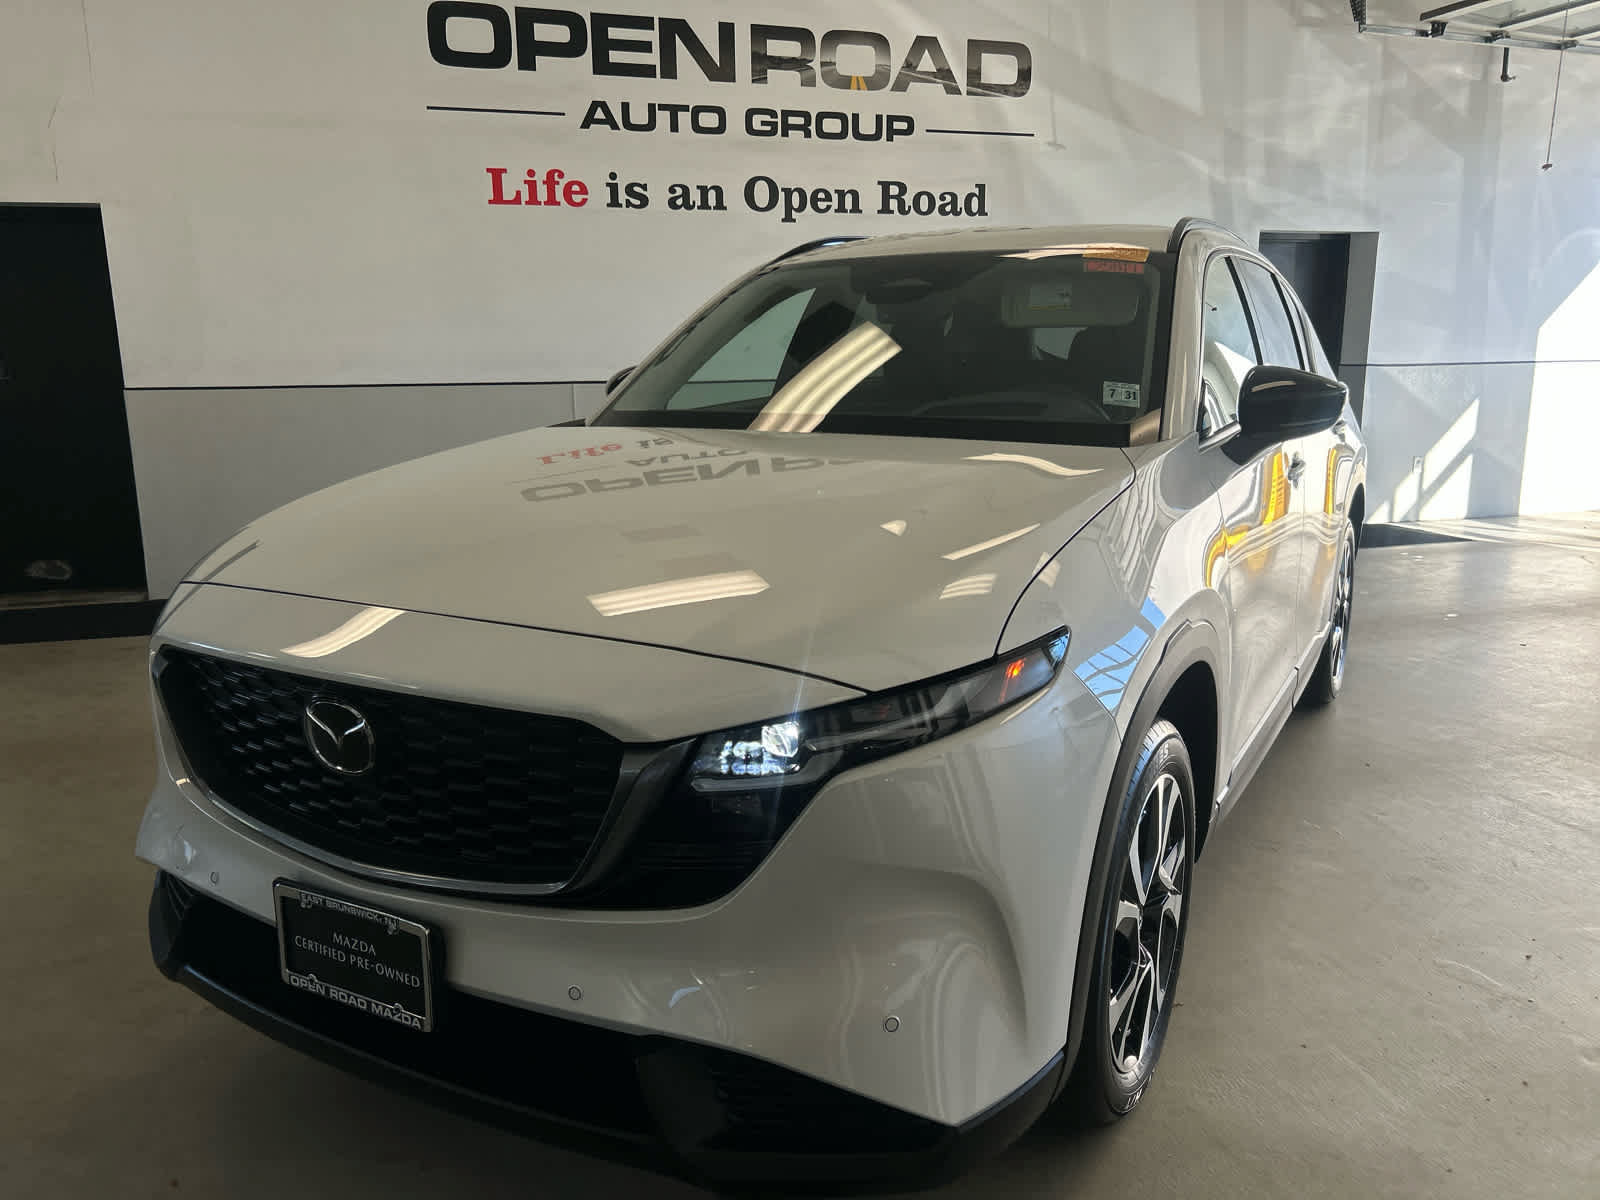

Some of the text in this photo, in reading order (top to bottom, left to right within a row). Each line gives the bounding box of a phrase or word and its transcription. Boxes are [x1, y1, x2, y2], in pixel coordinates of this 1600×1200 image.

[426, 0, 1033, 98] OPEN ROAD
[579, 100, 916, 143] AUTO GROUP
[485, 167, 989, 223] Life is an Open Road
[294, 935, 421, 989] CERTIFIED PRE-OWNED
[333, 932, 376, 957] MAZDA
[289, 974, 422, 1030] OPEN ROAD MAZDA
